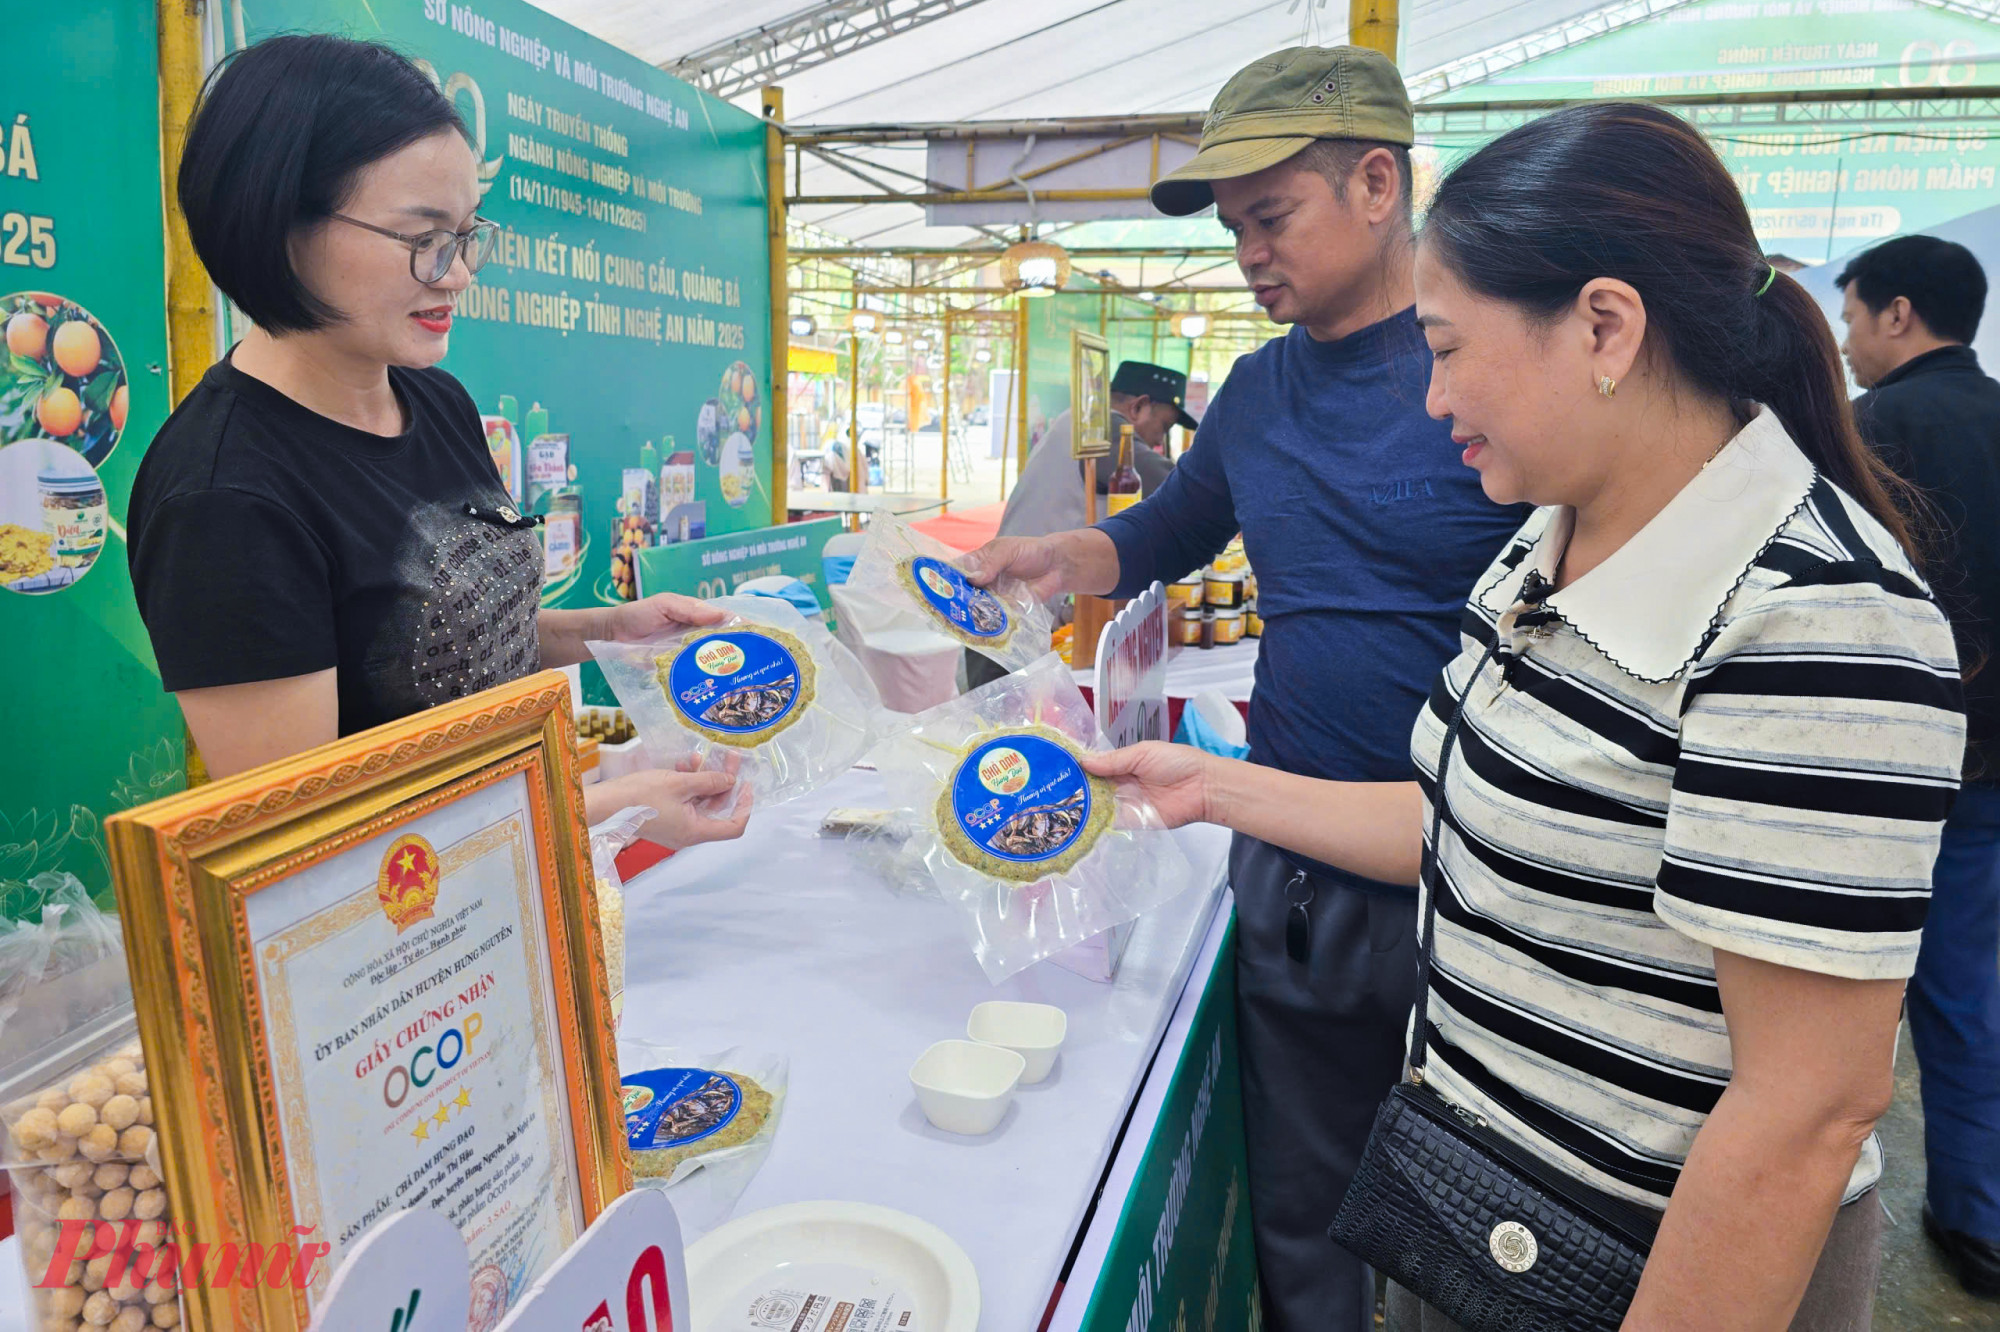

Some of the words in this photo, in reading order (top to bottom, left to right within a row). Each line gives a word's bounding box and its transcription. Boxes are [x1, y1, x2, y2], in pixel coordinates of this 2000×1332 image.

[451, 3, 496, 47] NÔNG
[499, 25, 551, 73] NGHIỆP
[554, 48, 571, 80] VÀ
[574, 60, 598, 90] MÔI
[600, 70, 644, 111] TRƯỜNG
[646, 94, 674, 129] NGHỆ
[675, 109, 689, 131] AN
[0, 112, 39, 180] Á
[507, 92, 543, 126] NGÀY
[547, 105, 590, 143] TRUYỀN
[594, 122, 628, 157] THỐNG
[509, 133, 554, 168] NGÀNH
[556, 146, 590, 179] NÔNG
[592, 163, 631, 194] NGHIỆP
[633, 171, 648, 197] VÀ
[649, 179, 666, 204] MÔI
[668, 185, 703, 216] TRƯỜNG
[535, 231, 567, 275] KẾT
[572, 240, 600, 282] NỐI
[604, 253, 645, 289] CUNG
[649, 257, 679, 300] CẦU,
[682, 265, 723, 305] QUẢNG
[725, 275, 740, 308] BÁ
[515, 290, 581, 337] NGHIỆP
[585, 292, 621, 336] TỈNH
[624, 306, 662, 346] NGHỆ
[665, 320, 684, 343] AN
[687, 315, 715, 347] NĂM
[718, 323, 744, 350] 2025
[510, 548, 532, 567] the
[698, 651, 714, 665] CHẢ
[717, 644, 736, 658] DAM
[680, 678, 715, 701] OCOP
[981, 762, 1000, 781] CHẢ
[1000, 752, 1020, 768] DAM
[965, 798, 1000, 825] OCOP
[343, 968, 366, 988] CỘNG
[366, 957, 384, 975] HÒA
[384, 948, 395, 963] XÃ
[395, 940, 410, 957] HỘI
[411, 928, 430, 947] CHỦ
[430, 917, 455, 937] NGHĨA
[455, 907, 470, 922] VIỆT
[469, 898, 484, 912] NAM
[370, 971, 385, 986] Độc
[385, 963, 398, 977] lập
[402, 953, 414, 965] Tự
[415, 947, 425, 958] do
[430, 933, 450, 949] Hạnh
[451, 924, 467, 942] phúc
[314, 1040, 333, 1061] ỦY
[334, 1025, 359, 1050] BAN
[360, 1004, 390, 1033] NHÂN
[391, 989, 414, 1012] DÂN
[415, 966, 452, 997] HUYỆN
[453, 949, 479, 974] HƯNG
[479, 925, 513, 956] NGUYÊN
[355, 1038, 393, 1079] GIẤY
[395, 1000, 455, 1049] CHỨNG
[457, 970, 496, 1010] NHẬN
[383, 1012, 483, 1109] OCOP
[339, 1222, 361, 1246] SẢN
[395, 1174, 414, 1197] CHẢ
[413, 1158, 433, 1182] DAM
[433, 1140, 457, 1165] HƯNG
[457, 1124, 475, 1146] ĐẠO
[487, 1178, 508, 1204] OCOP
[494, 1199, 511, 1218] SAO
